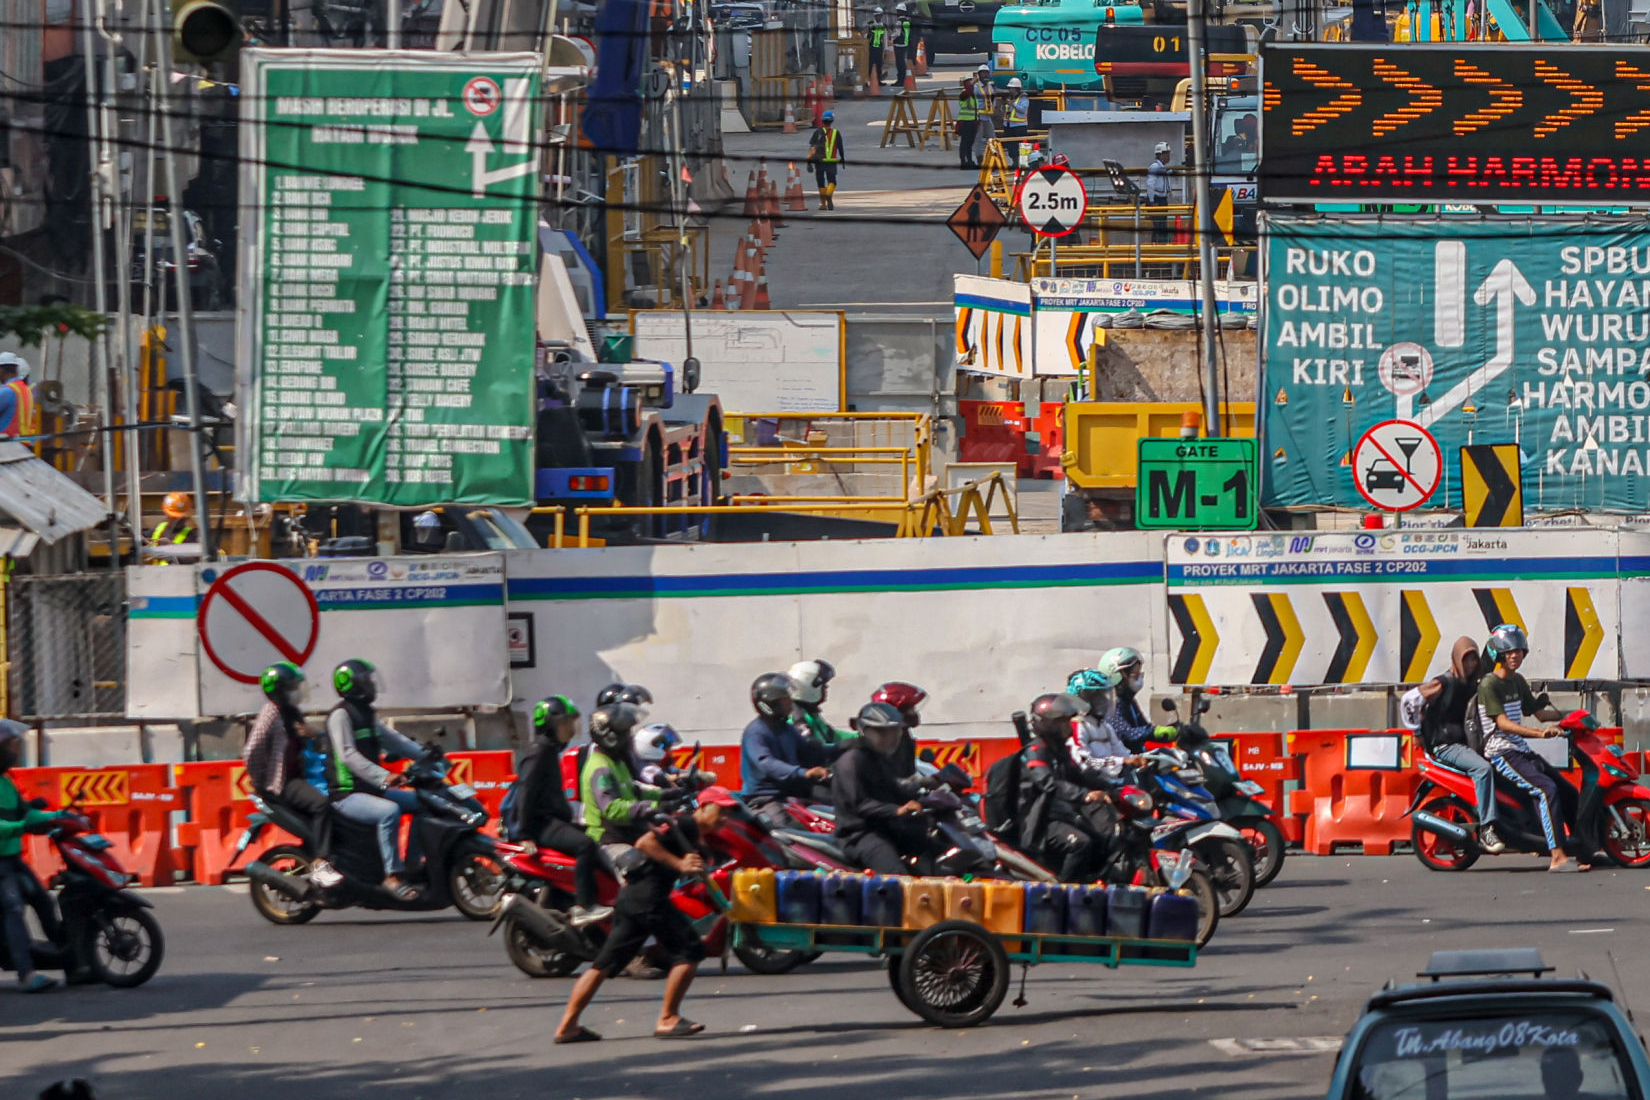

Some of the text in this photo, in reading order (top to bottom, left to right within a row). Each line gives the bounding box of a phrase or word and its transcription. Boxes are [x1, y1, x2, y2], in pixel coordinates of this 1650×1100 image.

[1026, 27, 1081, 42] CC 05
[1036, 44, 1096, 60] KOBELC
[1310, 156, 1433, 186] ARAH
[1028, 192, 1078, 210] 2.5m
[1286, 248, 1376, 277] RUKO
[1040, 298, 1064, 306] PROYEK
[1065, 298, 1078, 306] MRT
[1078, 299, 1105, 307] JAKARTA
[1106, 299, 1120, 307] FASE
[1127, 300, 1145, 308] CP202
[1277, 284, 1383, 314] OLIMO
[1277, 321, 1382, 349] AMBIL
[1292, 358, 1365, 386] KIRI
[1176, 446, 1218, 457] GATE
[1149, 470, 1247, 518] M-1
[1403, 543, 1458, 554] OCG-JPCN
[1466, 538, 1507, 551] Jakarta
[1183, 561, 1427, 577] PROYEK MRT JAKARTA FASE 2 CP202
[317, 590, 353, 601] ARTA
[356, 589, 392, 601] FASE
[394, 588, 402, 600] 2
